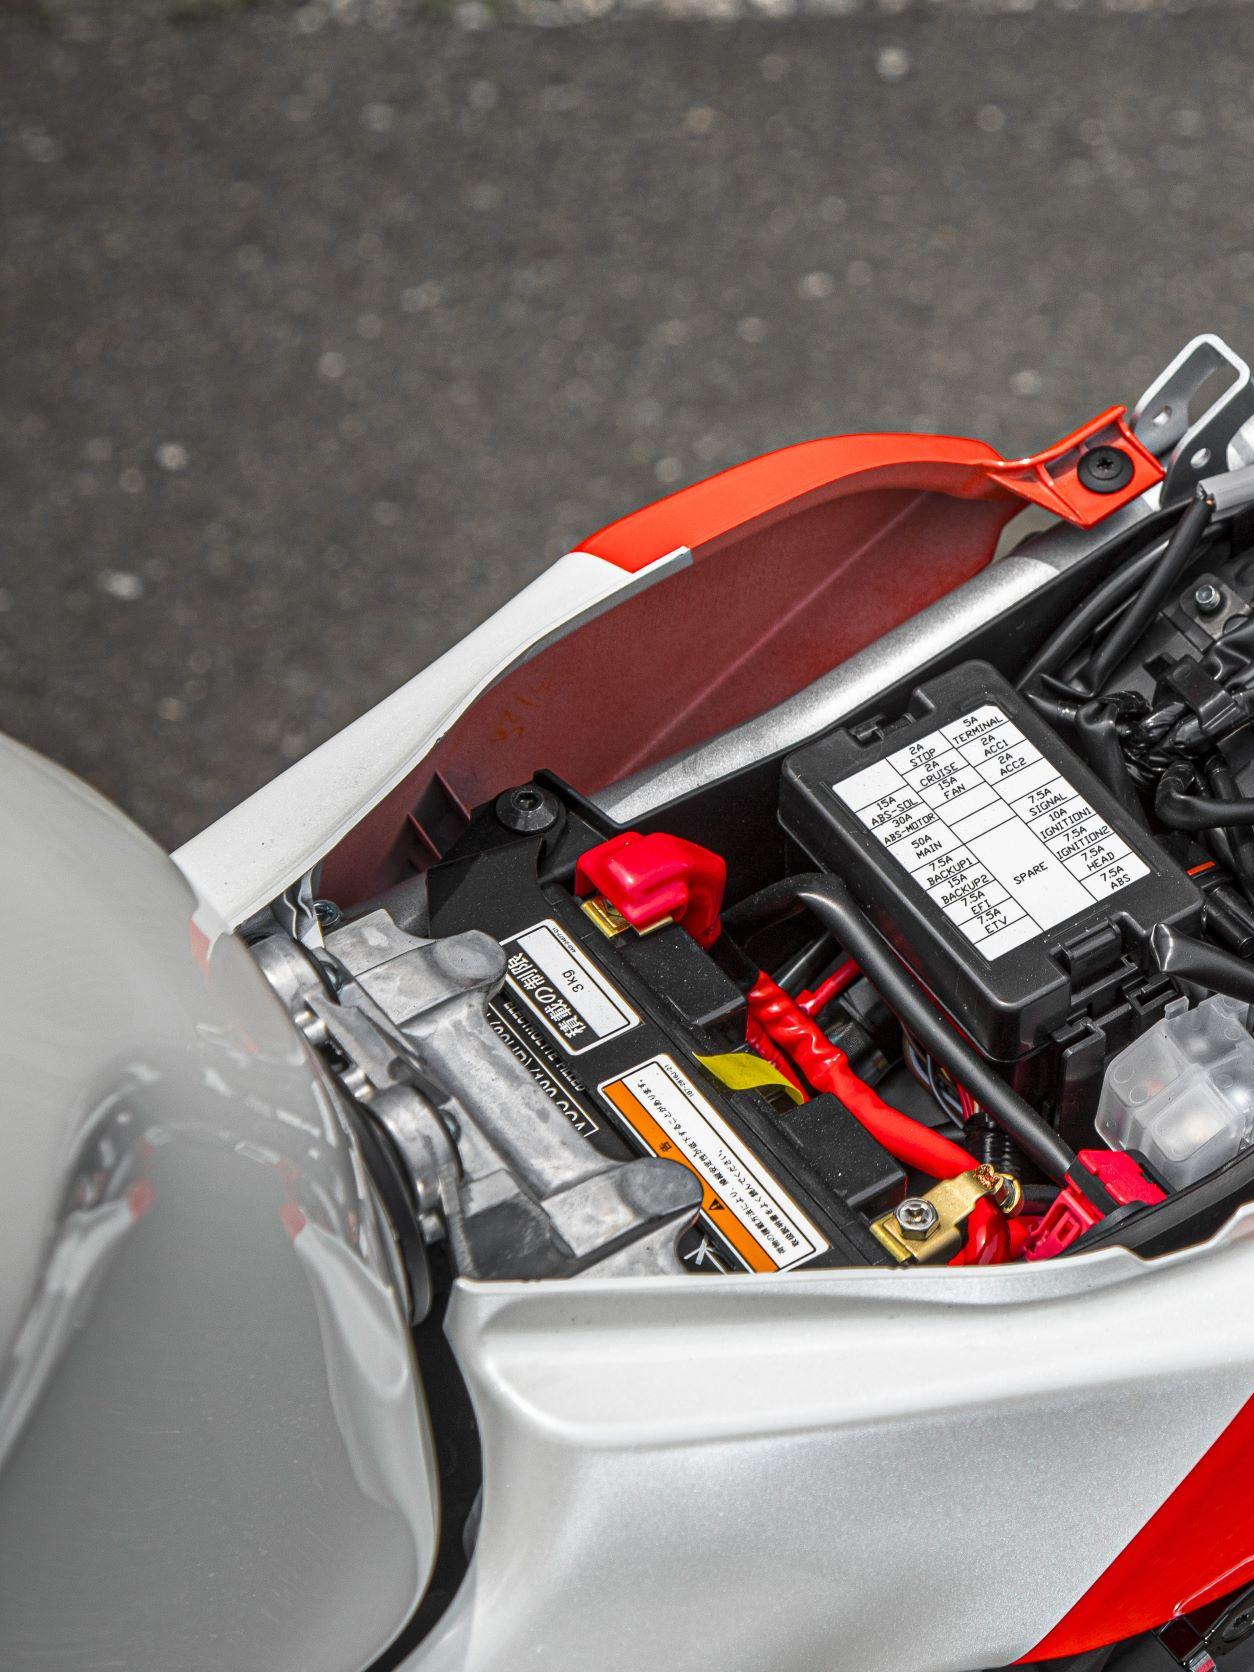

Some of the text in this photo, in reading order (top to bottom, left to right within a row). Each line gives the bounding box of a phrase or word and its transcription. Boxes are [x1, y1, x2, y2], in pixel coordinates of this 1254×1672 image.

[953, 715, 1004, 746] TERMINAL
[963, 716, 978, 728] 5A
[981, 734, 996, 746] 2A
[983, 739, 1009, 757] ACC1
[910, 743, 924, 755] 2A
[910, 748, 936, 767] STOP
[925, 760, 939, 772] 2A
[998, 752, 1012, 765] 2A
[1000, 757, 1027, 776] ACC2
[919, 762, 958, 787] CRUISE
[938, 777, 957, 790] 15A
[944, 783, 966, 800] FAN
[877, 796, 896, 810] 15A
[1028, 788, 1052, 804] 7.5A
[1029, 793, 1067, 816] SIGNAL
[870, 798, 918, 826] ABS-SOL
[1048, 808, 1067, 821] 10A
[883, 812, 936, 845] ABS-MOTOR
[892, 814, 912, 828] 30A
[1039, 808, 1092, 840] IGNITION1
[911, 834, 932, 849] 50A
[1063, 825, 1087, 842] 7.5A
[915, 841, 942, 859] MAIN
[1056, 826, 1110, 860] IGNITION2
[1081, 845, 1104, 862] 7.5A
[1086, 851, 1115, 871] HEAD
[927, 858, 973, 887] BACKUP1
[929, 856, 953, 872] 7.5A
[948, 874, 967, 889] 15A
[1013, 862, 1048, 885] SPARE
[1100, 865, 1124, 882] 7.5A
[1110, 874, 1131, 890] ABS
[941, 874, 989, 905] BACKUP2
[961, 890, 985, 907] 7.5A
[970, 900, 991, 916] EFI
[977, 908, 1001, 925] 7.5A
[985, 916, 1008, 934] ETV
[507, 952, 586, 1038] 積載の制限
